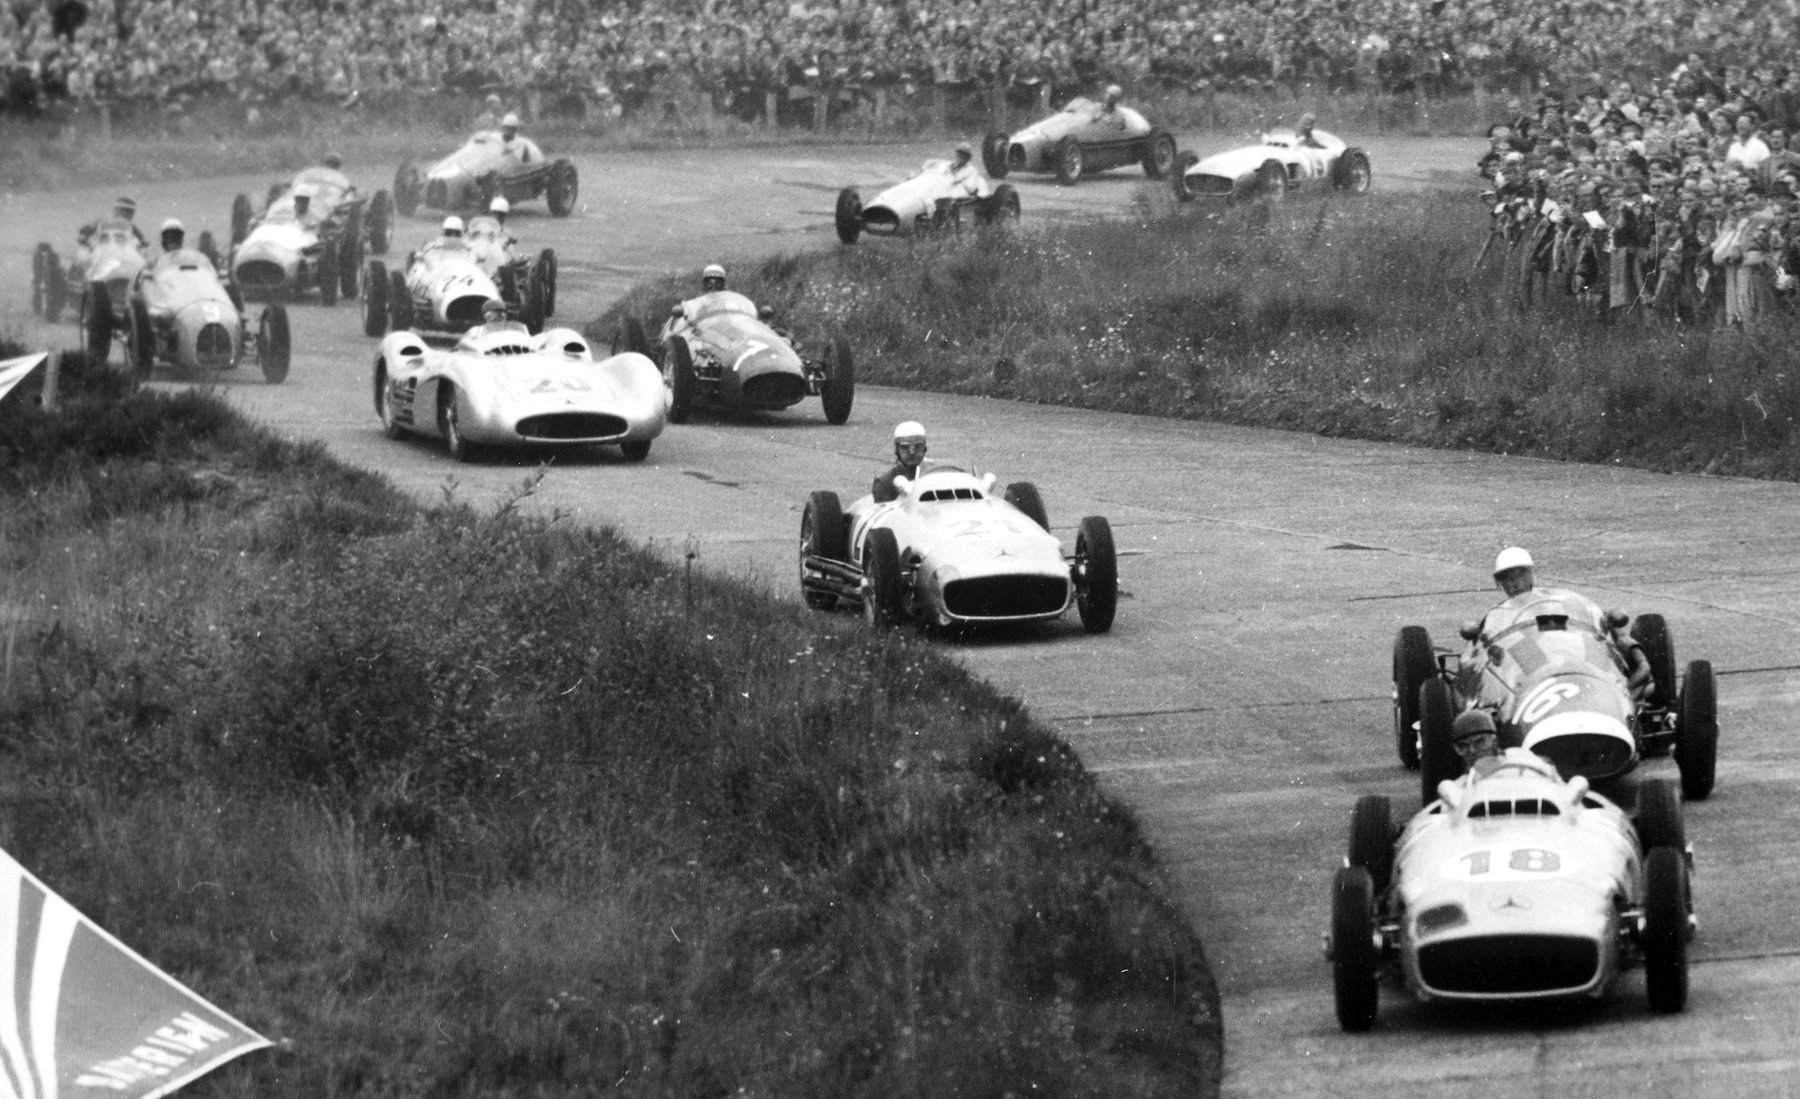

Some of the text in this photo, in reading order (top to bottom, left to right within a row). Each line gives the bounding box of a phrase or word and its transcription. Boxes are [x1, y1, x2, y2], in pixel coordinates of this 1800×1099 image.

[732, 339, 769, 372] 7
[947, 519, 1022, 538] 21
[1511, 677, 1580, 725] 16
[1459, 848, 1562, 876] 18
